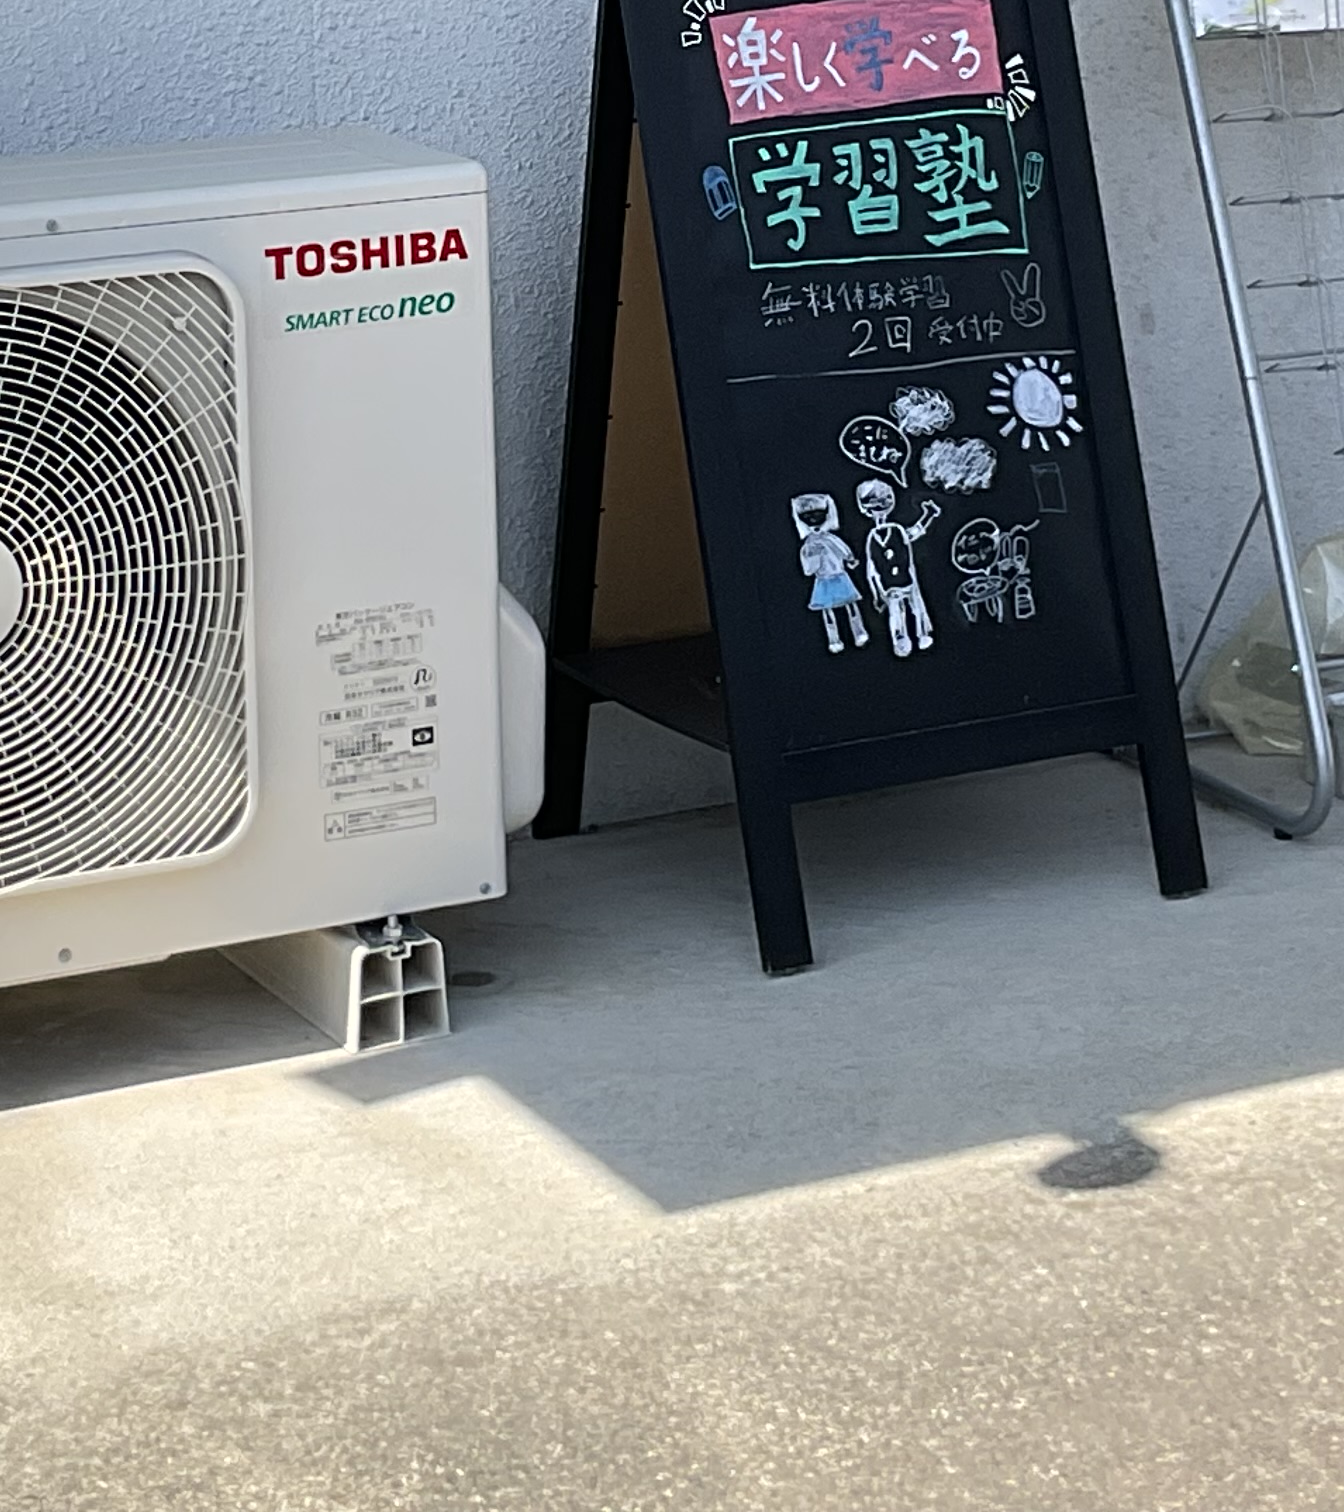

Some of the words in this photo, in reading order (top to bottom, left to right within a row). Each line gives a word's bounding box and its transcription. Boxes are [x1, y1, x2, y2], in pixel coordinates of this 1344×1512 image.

[722, 16, 982, 110] 楽しく学べる
[752, 123, 1010, 252] 学習塾
[264, 228, 468, 280] TOSHIBA
[285, 308, 354, 333] SMART
[357, 303, 394, 324] ECO
[398, 291, 455, 319] neo
[761, 275, 950, 327] 無料体験学習
[849, 316, 911, 358] 2回
[928, 310, 1003, 345] 受付中
